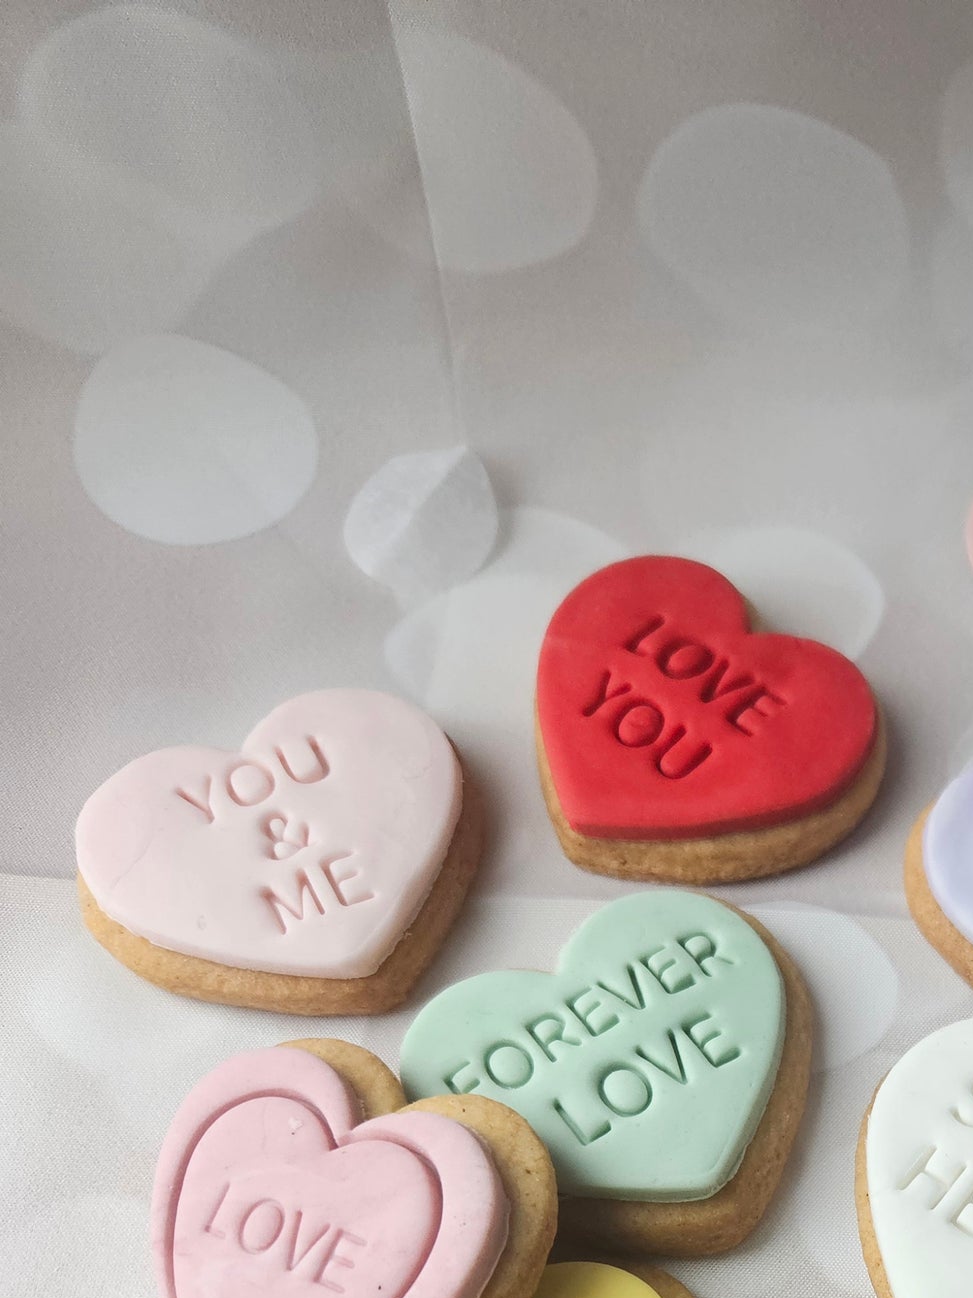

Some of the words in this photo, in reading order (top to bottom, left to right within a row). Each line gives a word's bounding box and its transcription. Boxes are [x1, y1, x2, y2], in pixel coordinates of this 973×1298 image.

[582, 670, 713, 780] YOU
[623, 614, 787, 738] LOVE
[174, 735, 331, 824] YOU
[260, 812, 310, 860] &
[260, 850, 375, 935] ME
[443, 931, 734, 1095] FOREVER
[553, 1013, 742, 1146] LOVE
[204, 1182, 366, 1294] LOVE
